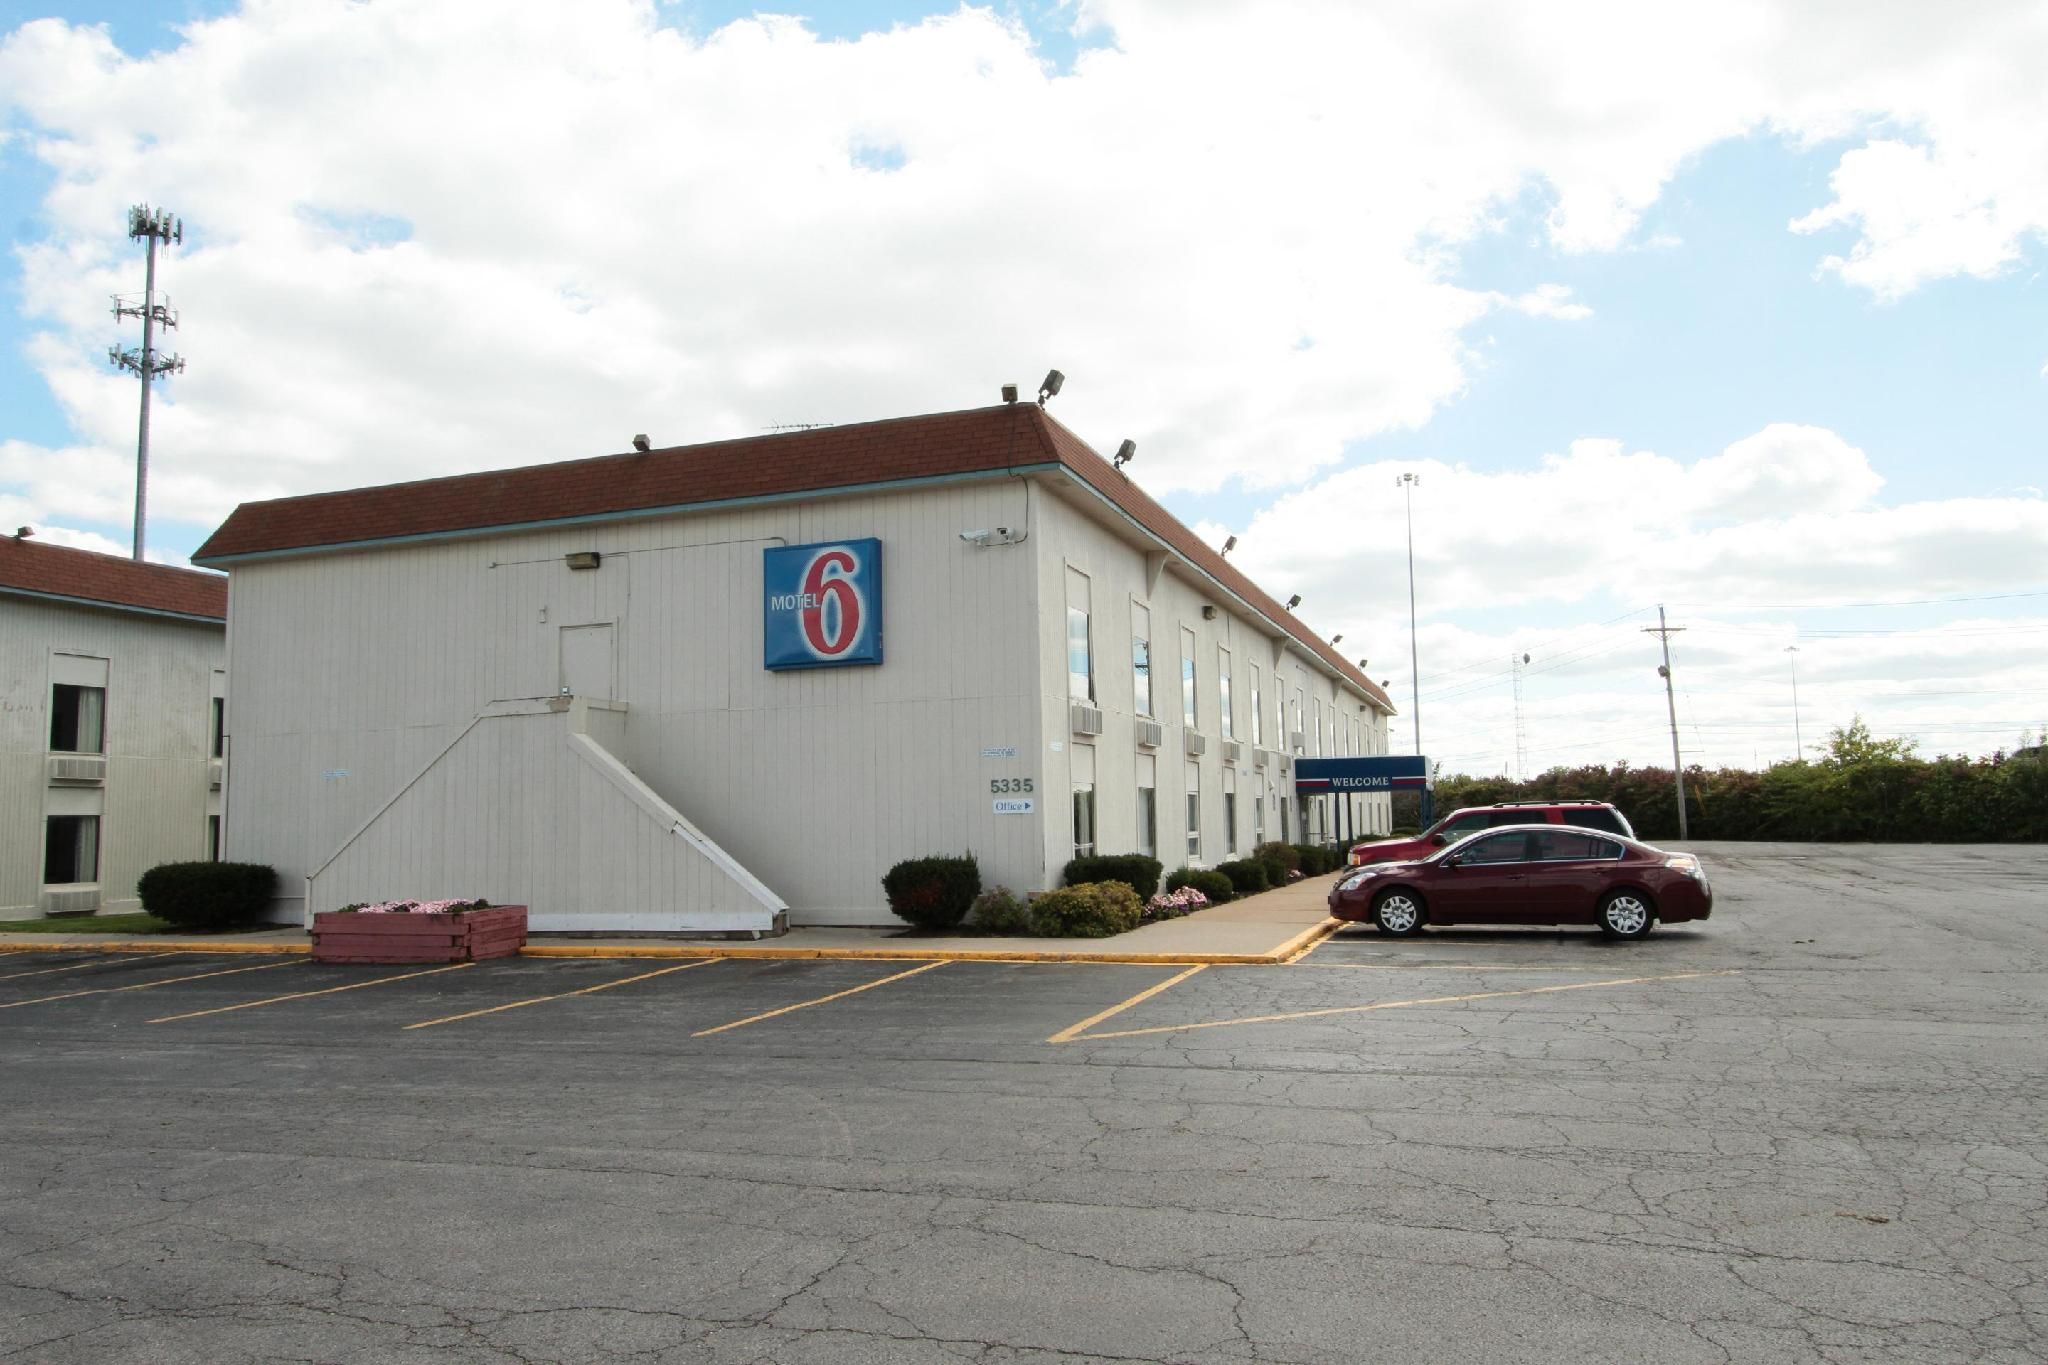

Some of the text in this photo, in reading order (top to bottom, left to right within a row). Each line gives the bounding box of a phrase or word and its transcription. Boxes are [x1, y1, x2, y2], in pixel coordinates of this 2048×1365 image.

[771, 549, 861, 656] MOTEL 6
[990, 778, 1034, 793] 5335
[1332, 776, 1389, 787] WELCOME
[995, 802, 1022, 811] Office
